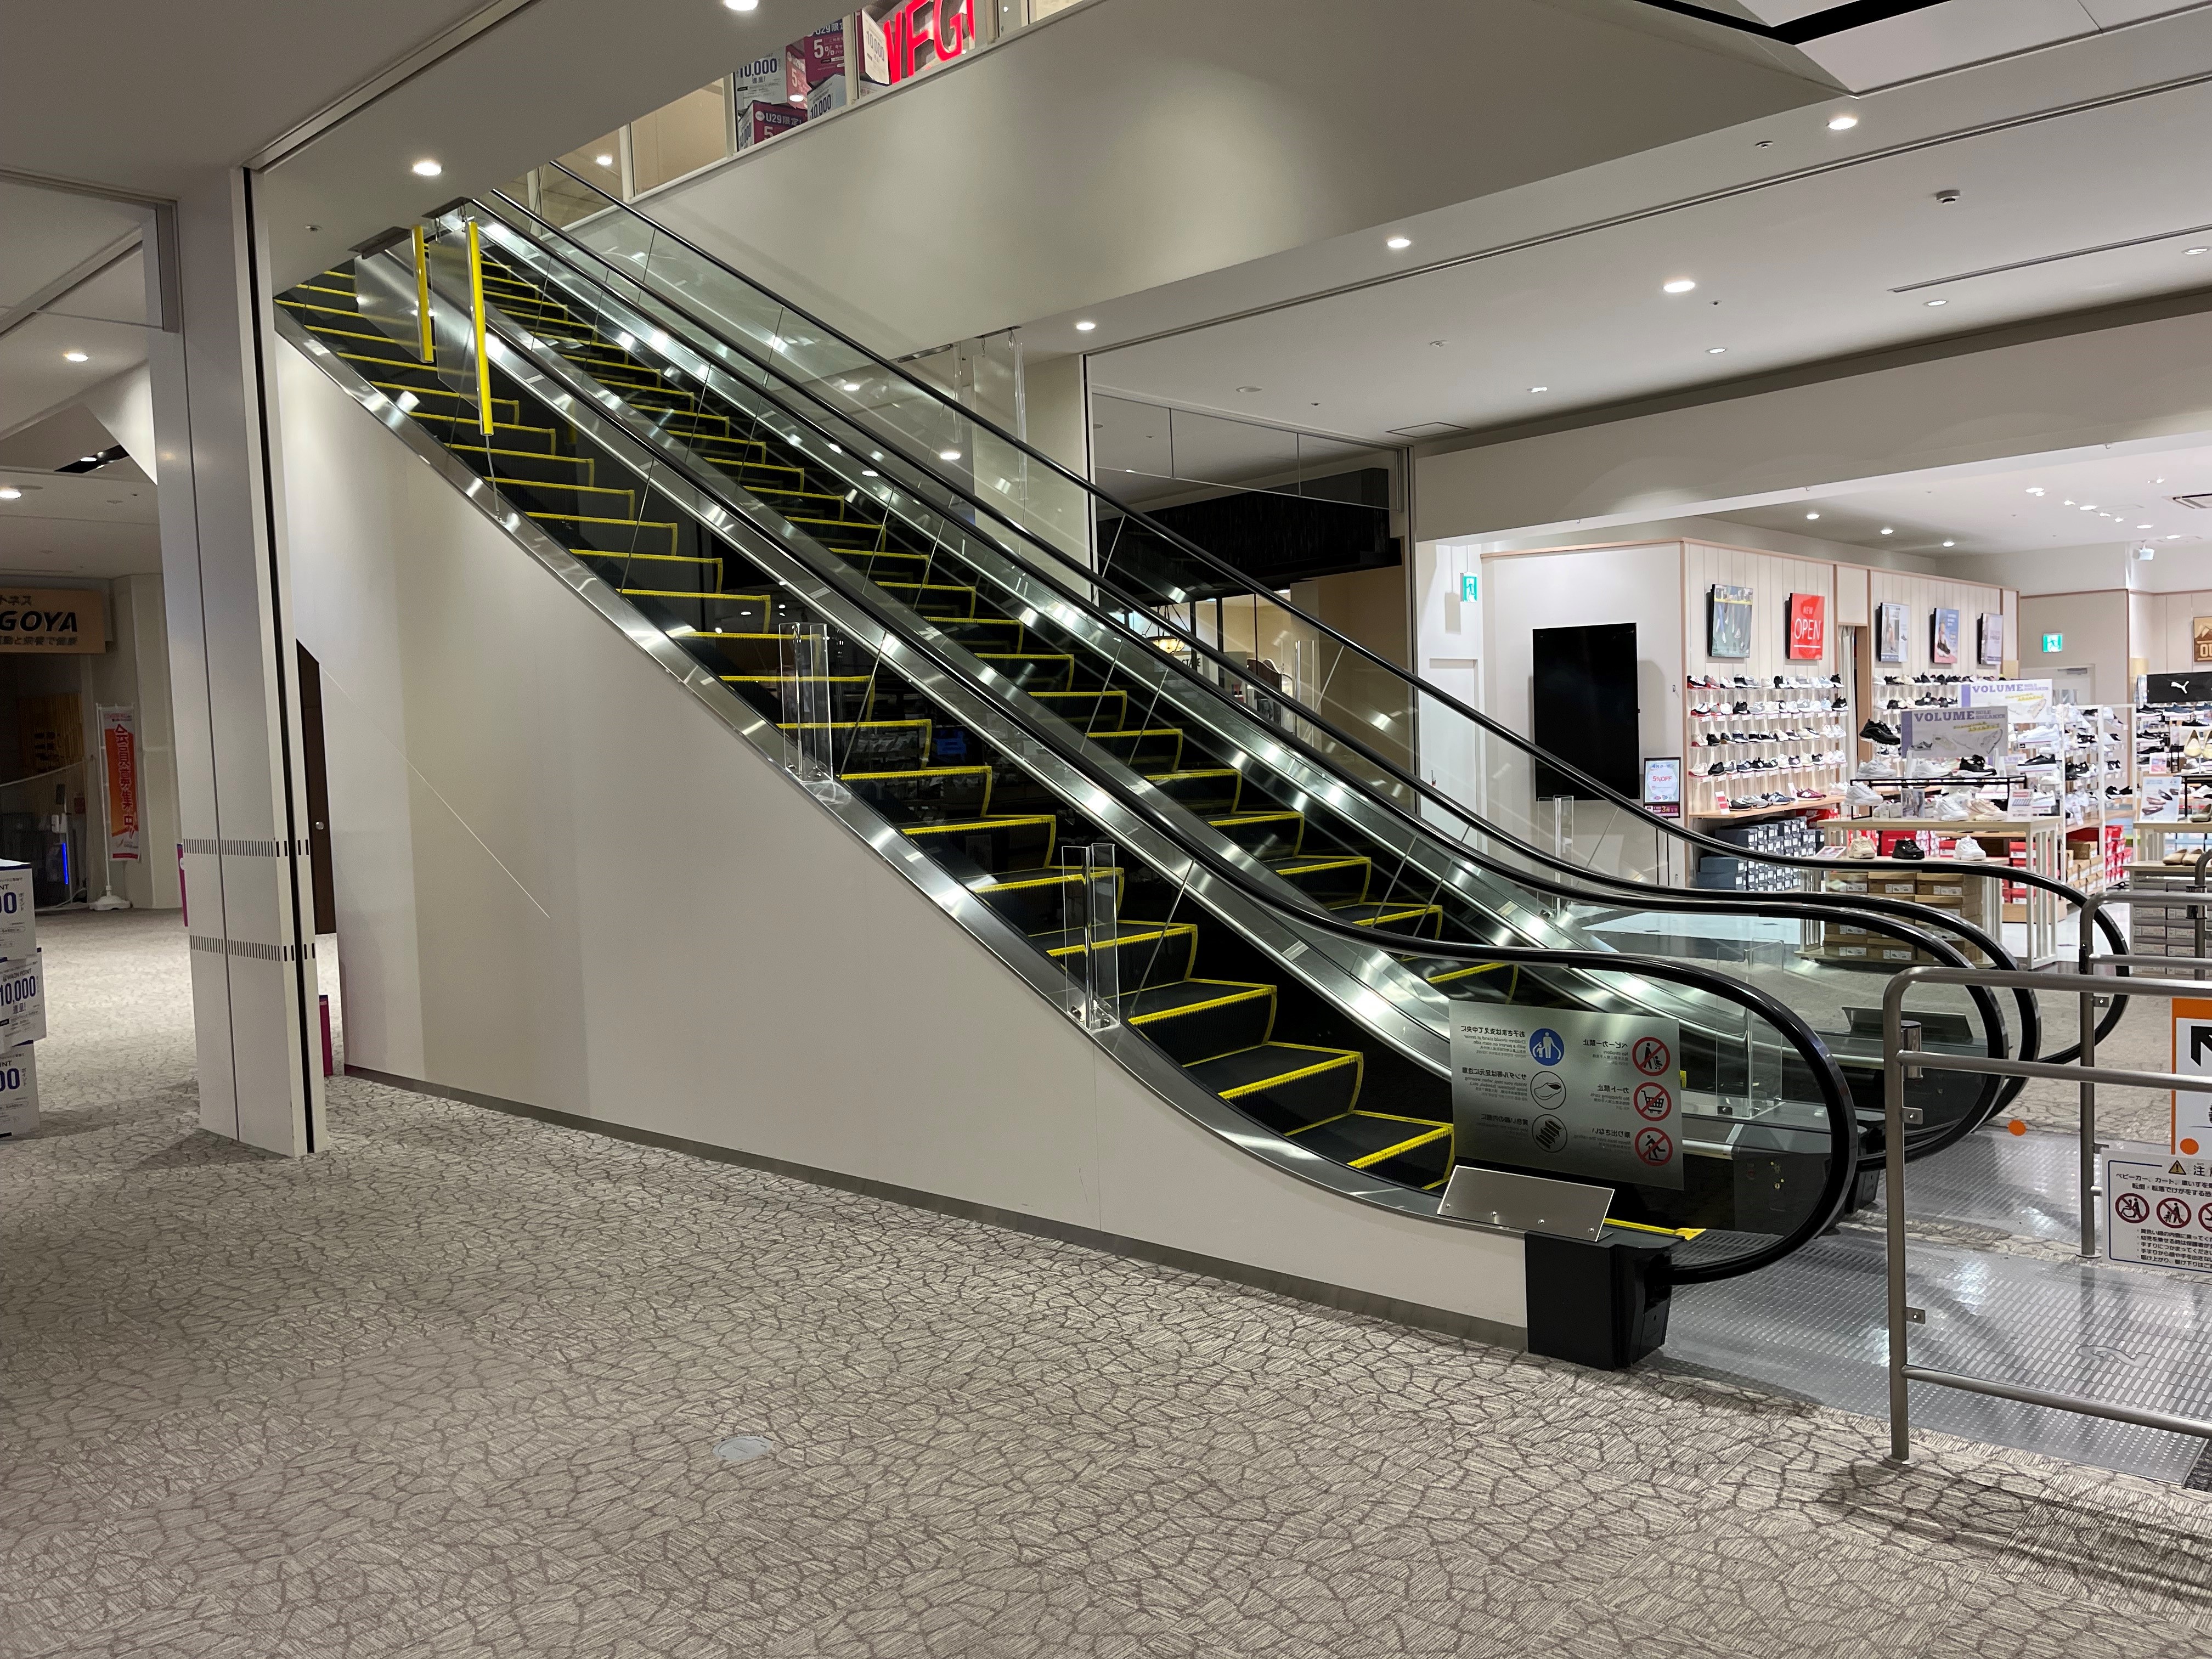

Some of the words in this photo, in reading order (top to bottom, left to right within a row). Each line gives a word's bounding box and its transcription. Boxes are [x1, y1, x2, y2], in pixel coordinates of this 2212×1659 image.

[814, 39, 834, 58] 5%
[1803, 606, 1813, 614] NEW
[0, 610, 77, 632] GOYA
[1794, 618, 1821, 640] OPEN
[1972, 684, 2023, 693] VOLUME
[1914, 711, 1974, 721] VOLUME
[2193, 1165, 2212, 1177] 注
